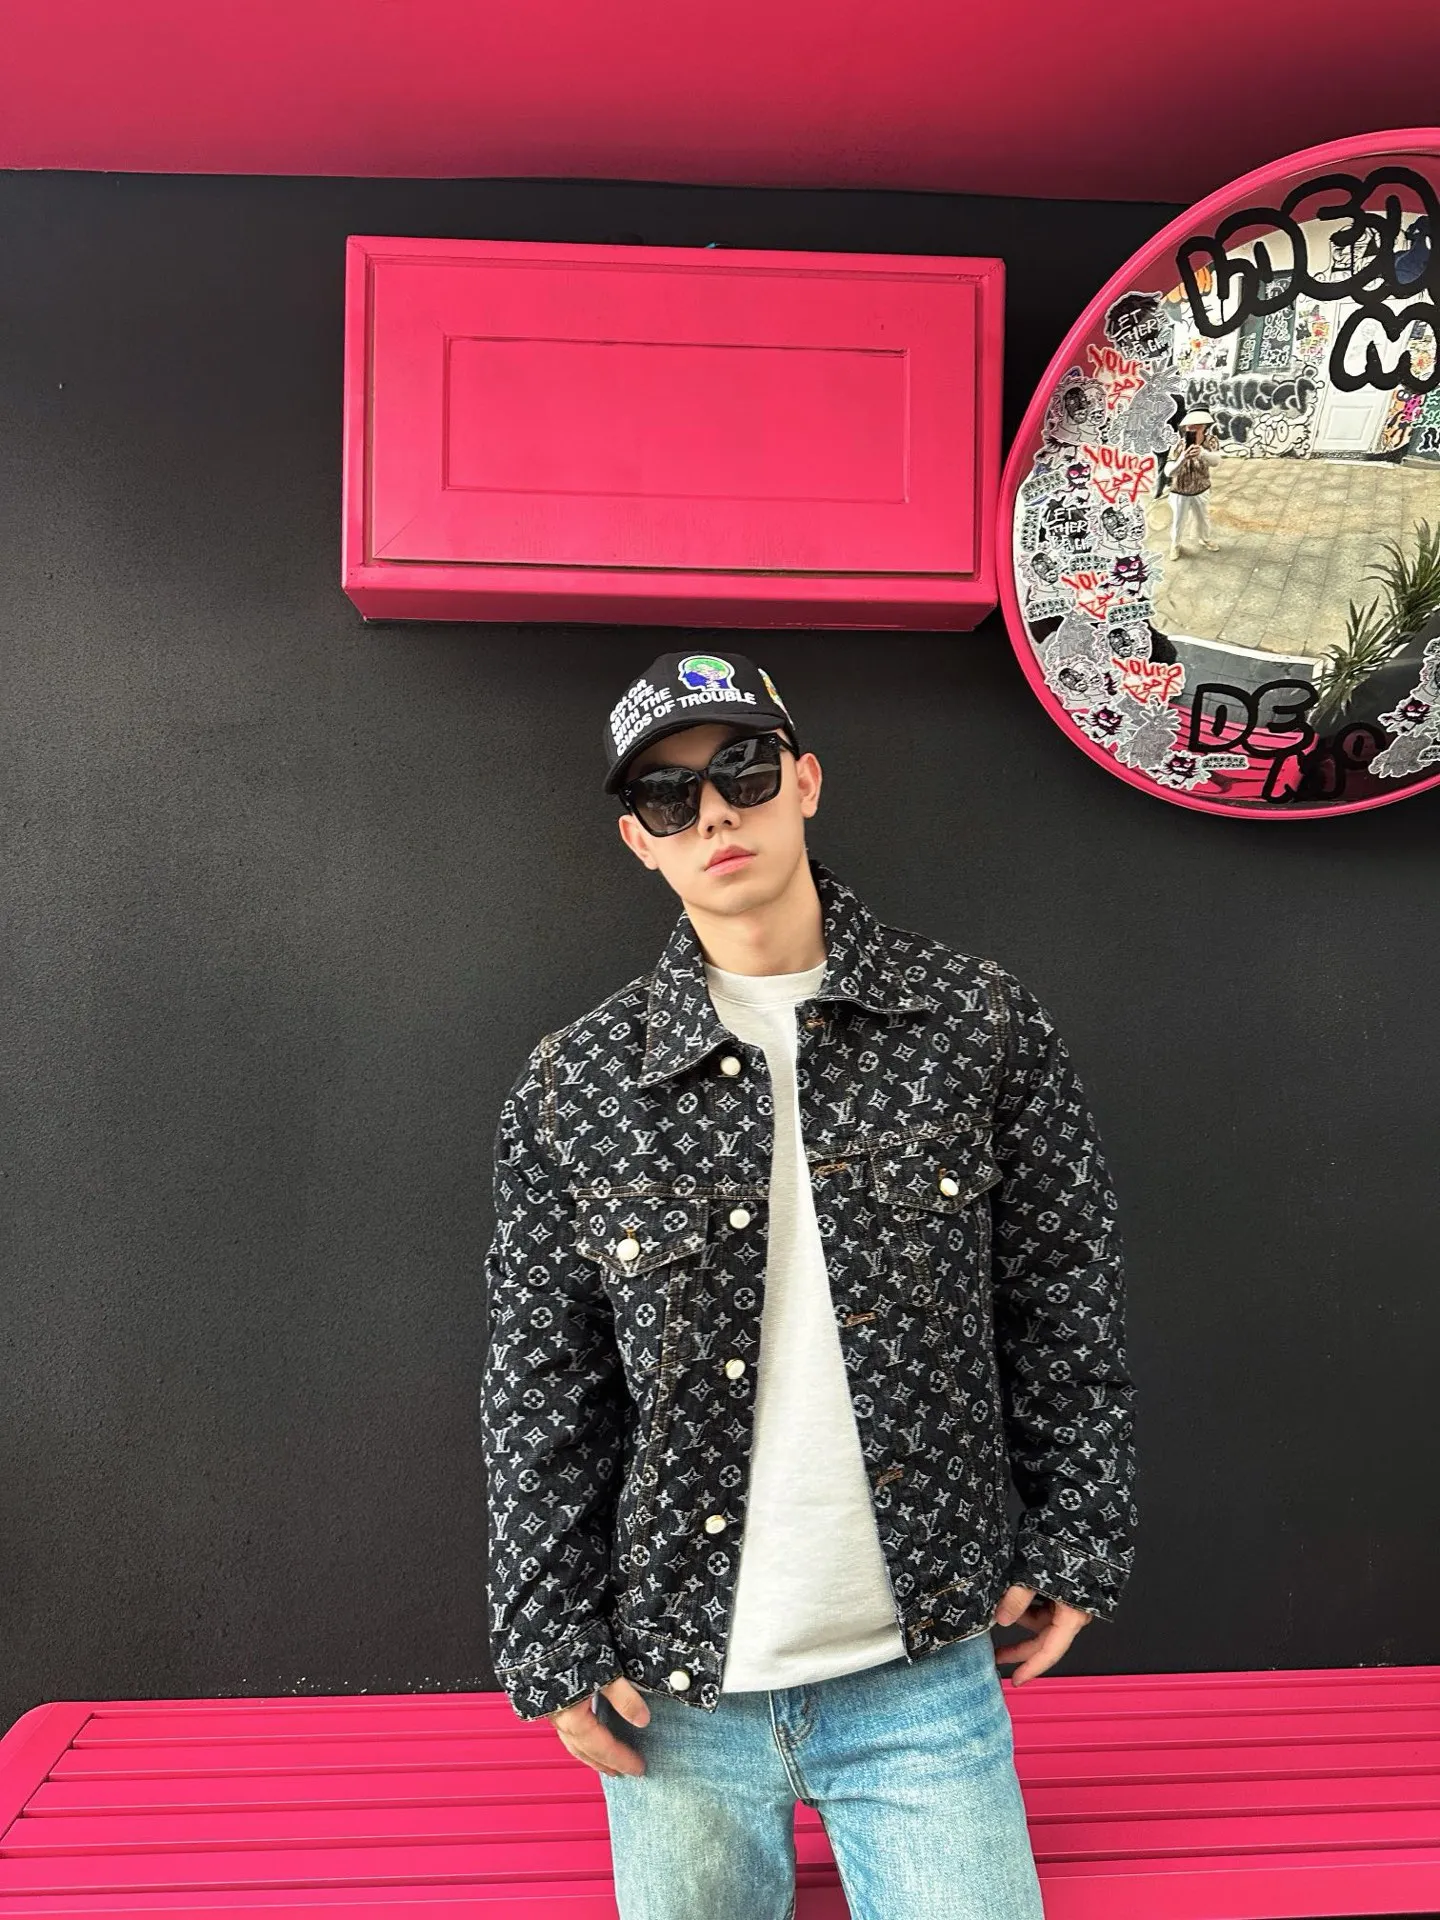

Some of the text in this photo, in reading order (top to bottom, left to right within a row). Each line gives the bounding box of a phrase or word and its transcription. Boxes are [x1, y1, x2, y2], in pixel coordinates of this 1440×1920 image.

[611, 684, 655, 735] MY LIFE
[613, 687, 671, 745] WITH THE
[616, 689, 757, 756] CHAOS OF TROUBLE
